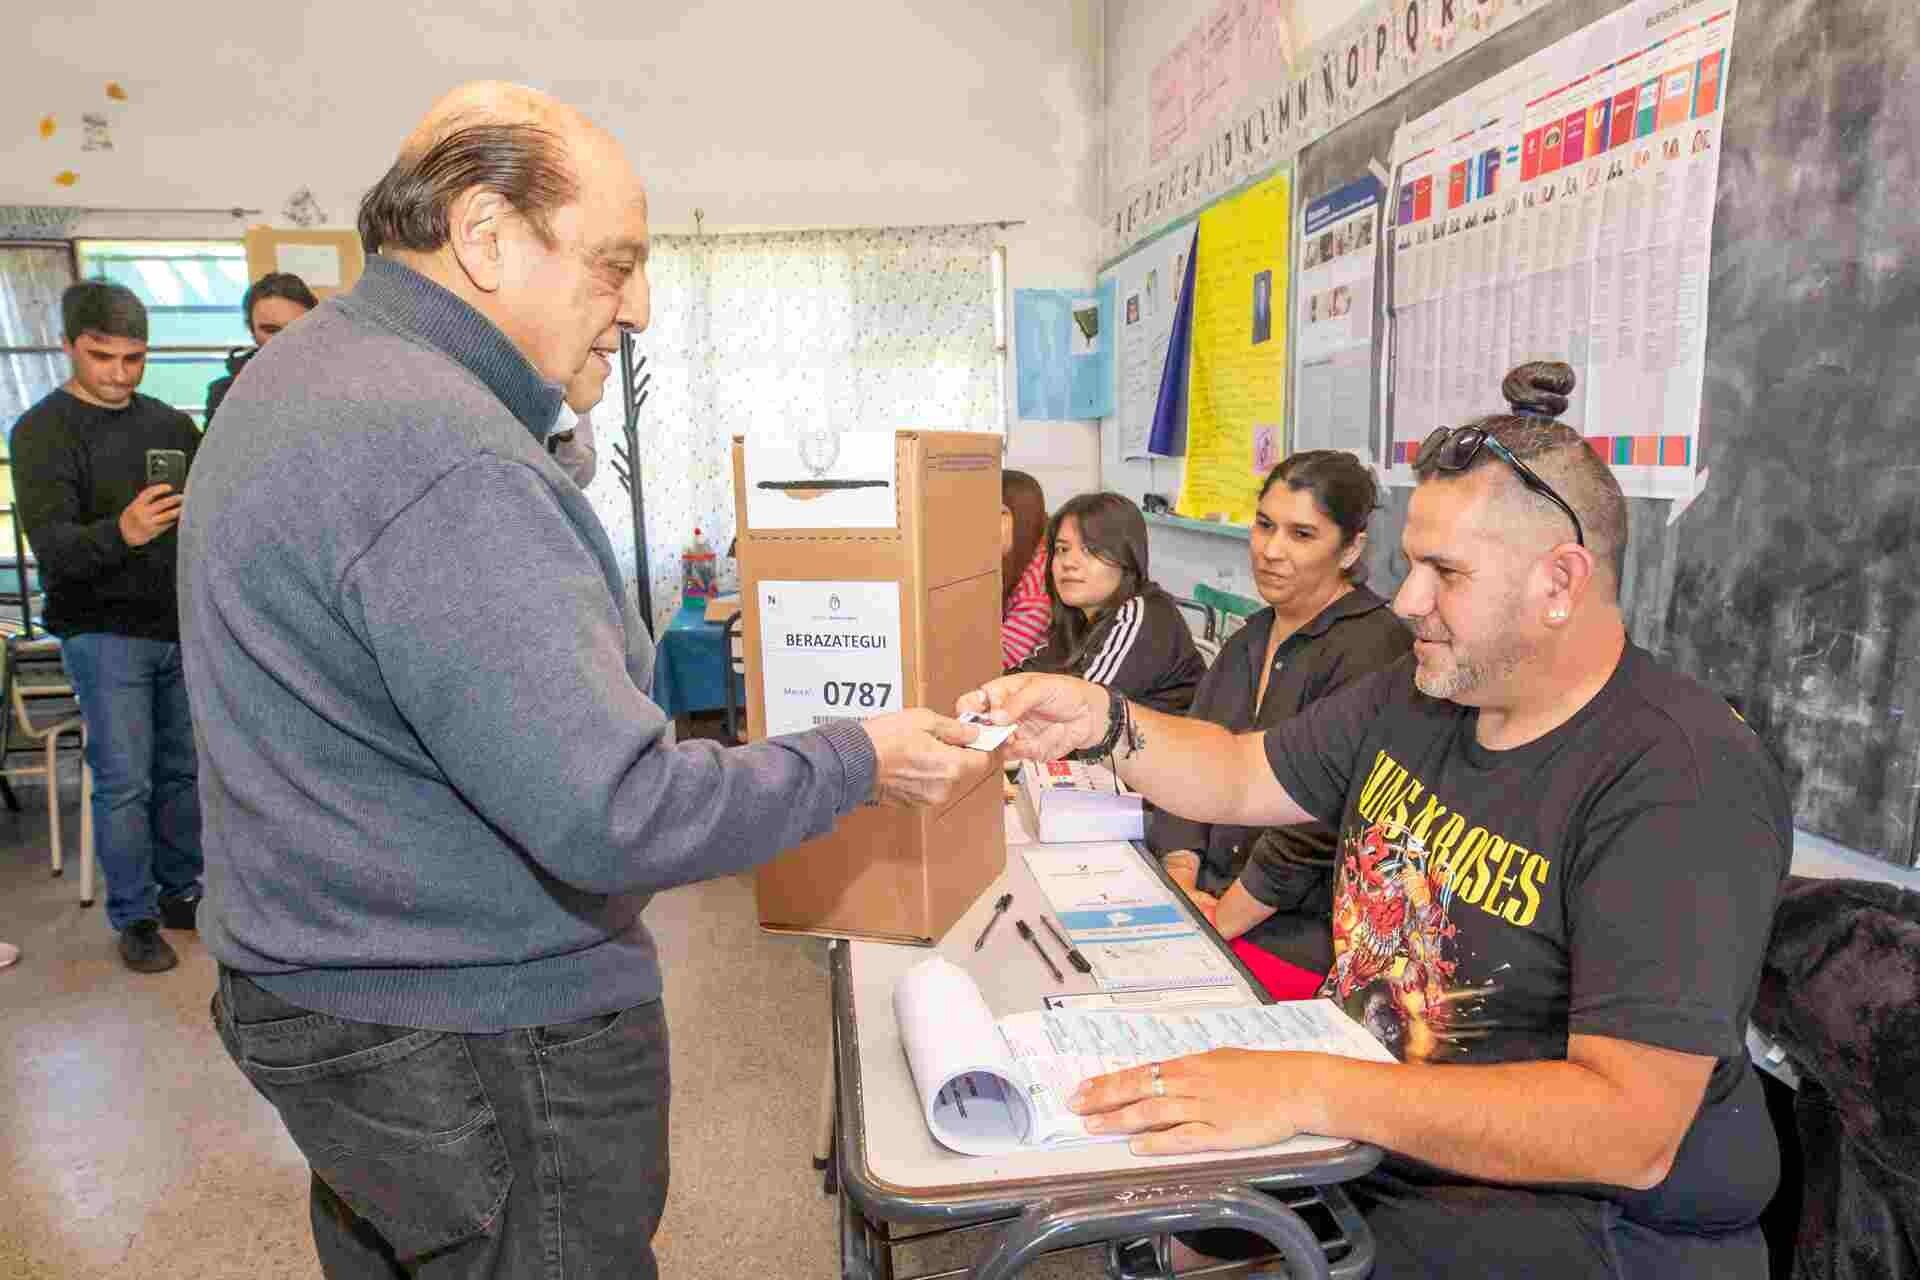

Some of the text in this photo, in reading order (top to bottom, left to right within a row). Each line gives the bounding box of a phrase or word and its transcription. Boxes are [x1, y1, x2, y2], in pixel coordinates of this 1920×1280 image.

[1406, 0, 1419, 52] Q
[785, 633, 888, 649] BERAZATEGUI
[823, 681, 892, 708] 0787
[1429, 812, 1551, 928] ROSES
